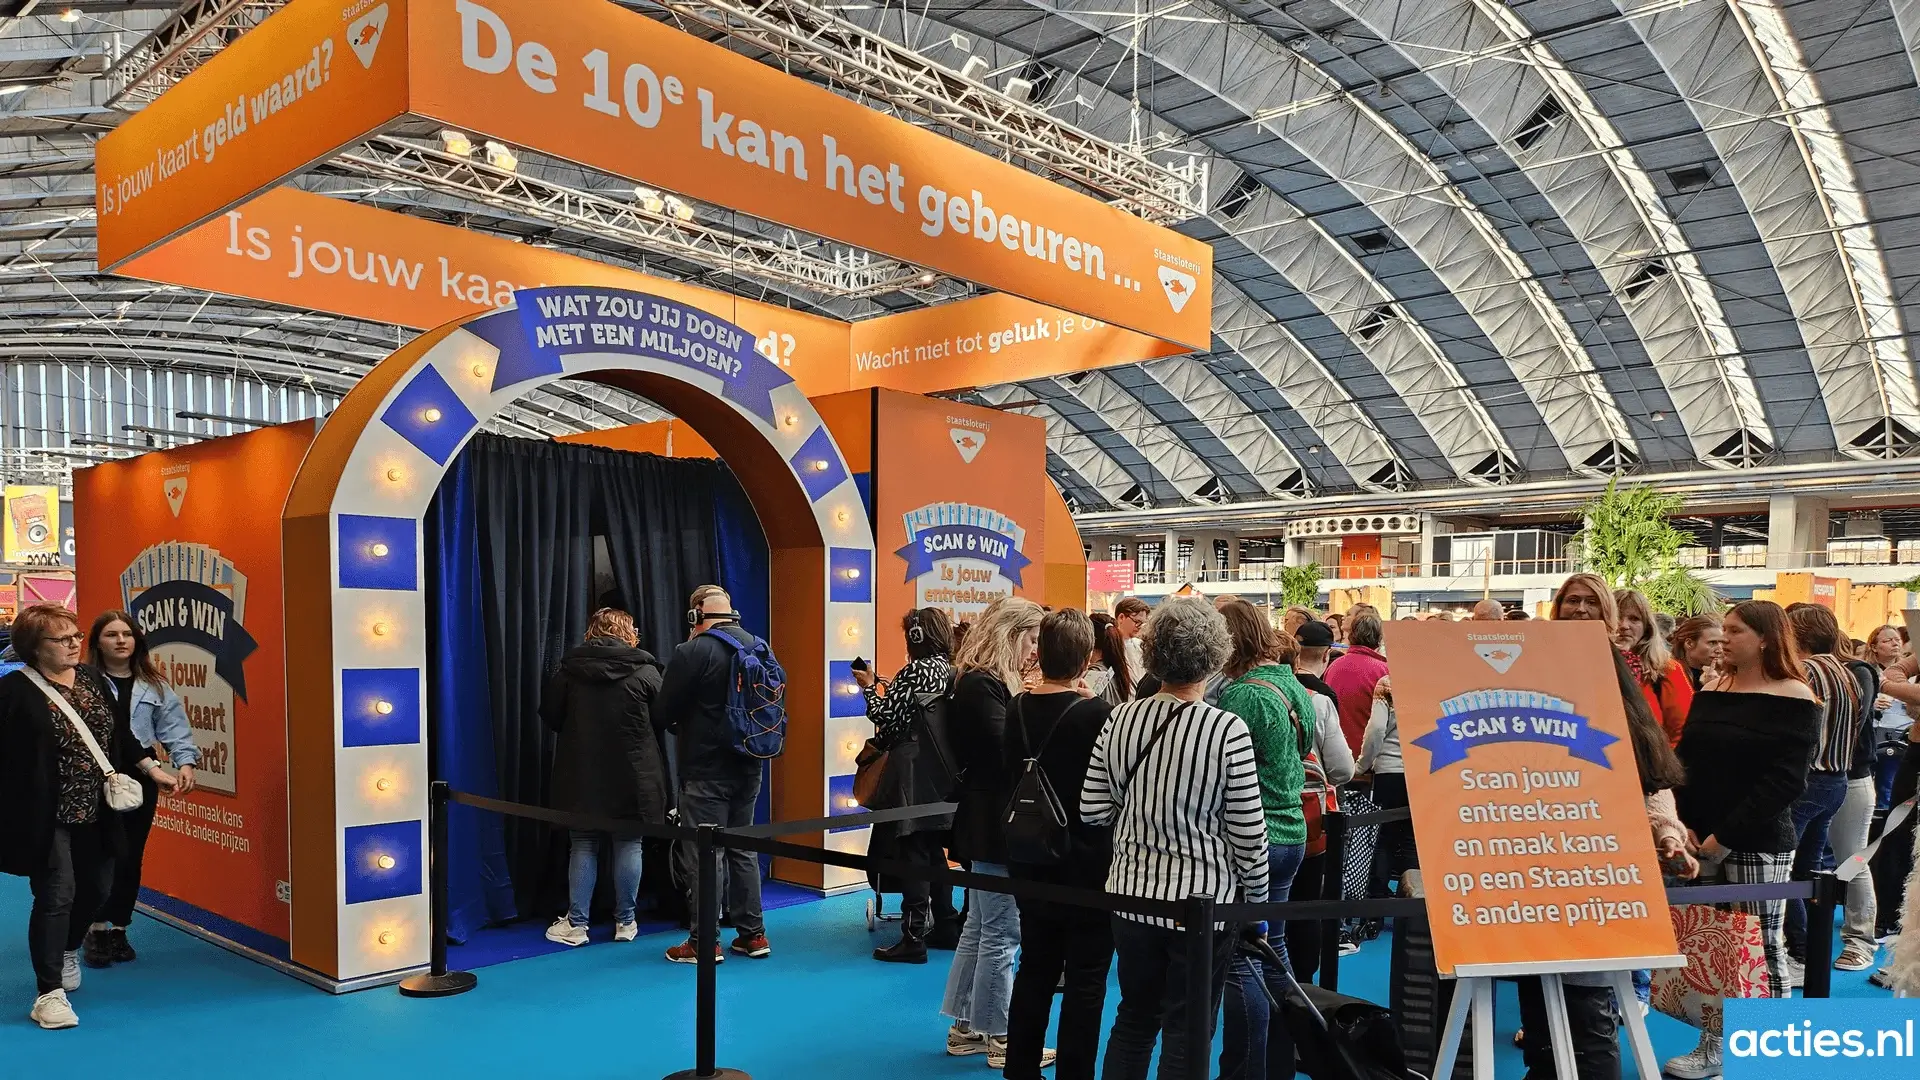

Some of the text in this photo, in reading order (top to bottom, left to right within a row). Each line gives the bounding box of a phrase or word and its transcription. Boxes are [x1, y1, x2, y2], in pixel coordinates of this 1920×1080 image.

[102, 37, 335, 216] Is jouw kaart geld waard?
[456, 0, 557, 94] De
[697, 88, 808, 181] kan
[823, 134, 905, 214] het
[918, 183, 1106, 281] gebeuren
[225, 210, 272, 261] Is
[288, 225, 424, 291] jouw
[438, 255, 527, 308] kaa
[1153, 247, 1201, 276] Staatsloterij
[536, 295, 743, 354] WAT ZOU JIJ DOEN
[535, 323, 743, 379] MET EEN MILJOEN?
[856, 345, 910, 373] Wacht
[914, 337, 951, 362] niet
[956, 331, 984, 353] tot
[987, 317, 1050, 355] geluk
[1055, 312, 1075, 342] je
[946, 415, 991, 432] Staatsloterij
[160, 461, 191, 477] Staatsloterij
[923, 533, 1009, 560] SCAN & WIN
[940, 563, 992, 585] Is jouw
[137, 597, 227, 641] SCAN & WIN
[1467, 633, 1525, 642] Staatsloterij
[170, 654, 208, 691] jouw
[1449, 715, 1578, 741] SCAN & WIN
[1459, 766, 1582, 794] Scan jouw
[167, 797, 187, 814] kaart
[187, 803, 198, 817] en
[199, 804, 222, 823] maak
[222, 806, 244, 828] kans
[1458, 797, 1602, 824] entreekaart
[185, 819, 191, 836] &
[192, 823, 220, 844] andere
[221, 830, 250, 854] prijzen
[1453, 830, 1620, 857] en maak kans
[1443, 862, 1644, 897] op een Staatslot
[1452, 897, 1649, 927] & andere prijzen
